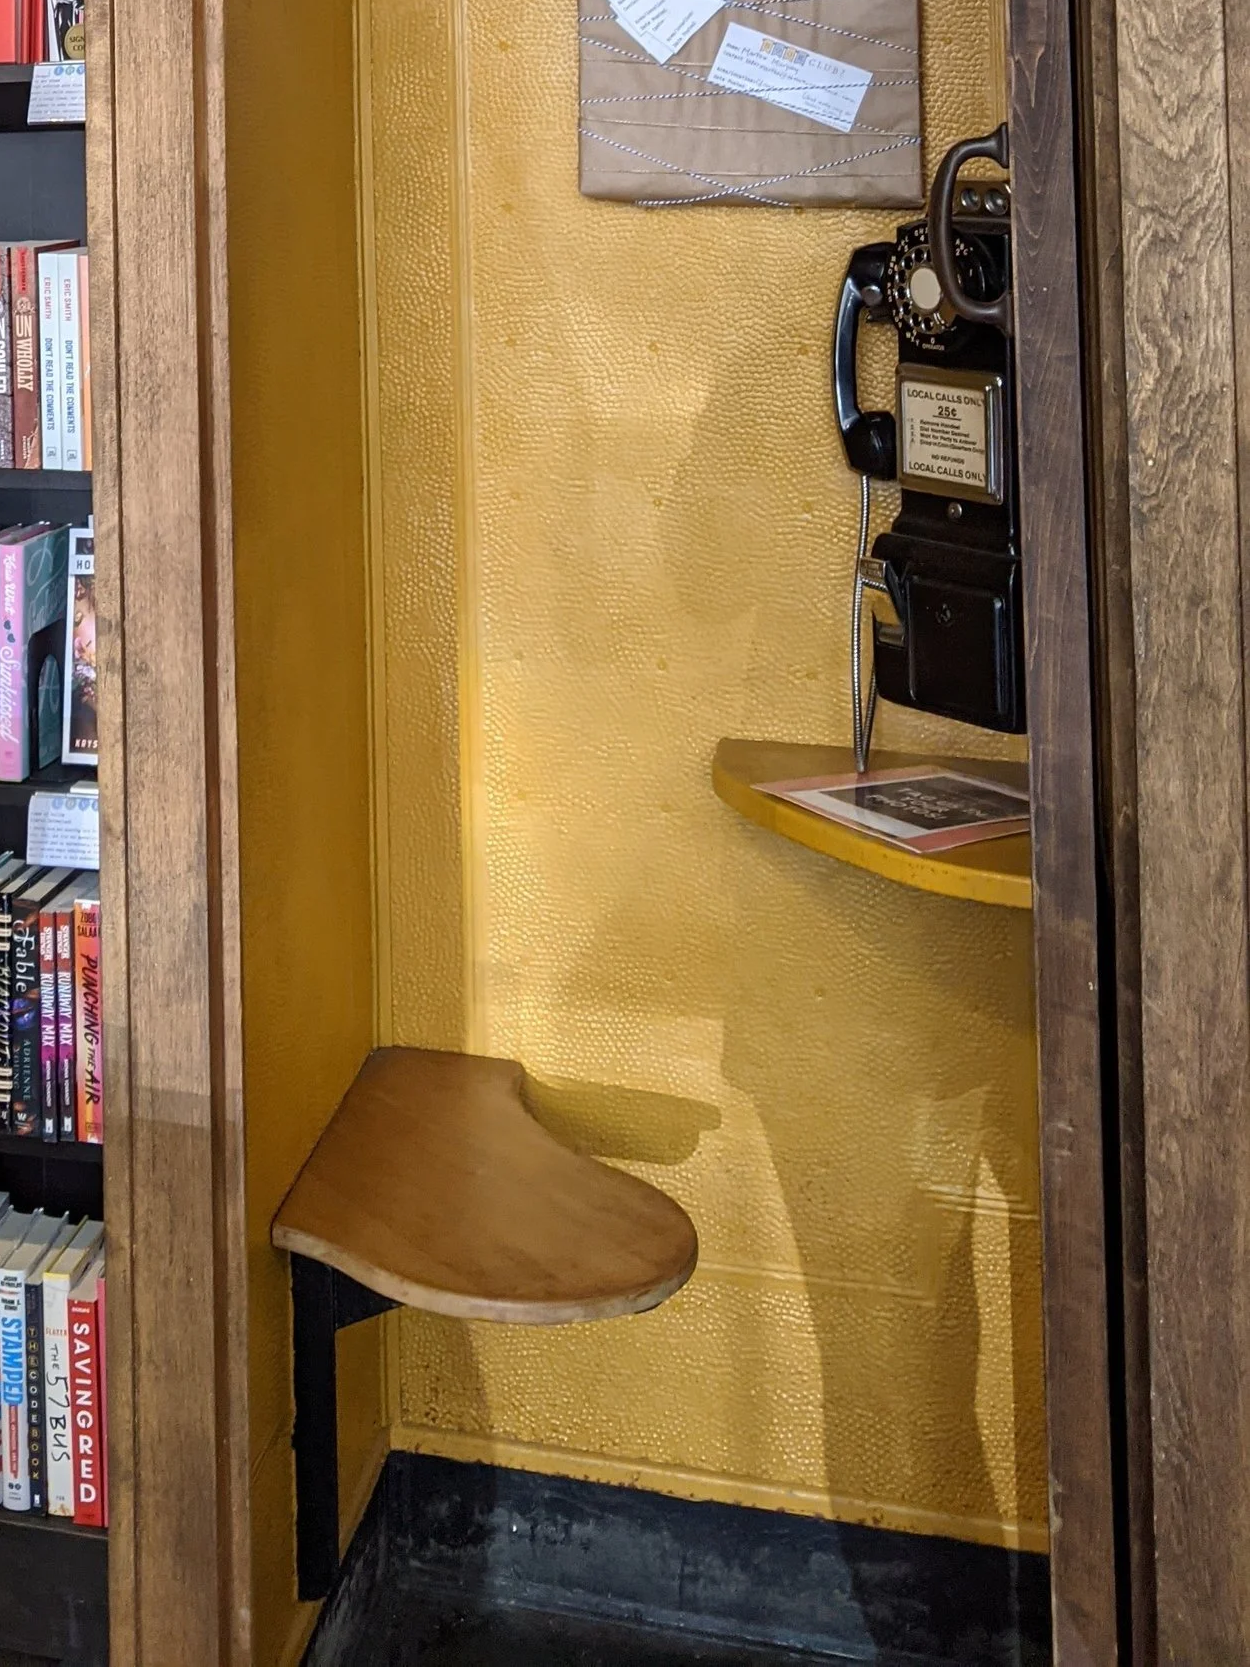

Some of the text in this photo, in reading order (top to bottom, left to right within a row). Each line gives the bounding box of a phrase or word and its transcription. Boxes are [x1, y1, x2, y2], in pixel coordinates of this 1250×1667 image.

[907, 389, 934, 400] LOCAL
[935, 393, 962, 404] CALLS
[937, 406, 957, 417] 25¢
[909, 462, 937, 474] LOCAL
[937, 465, 963, 478] CALLS
[73, 1322, 96, 1504] SAVING RED
